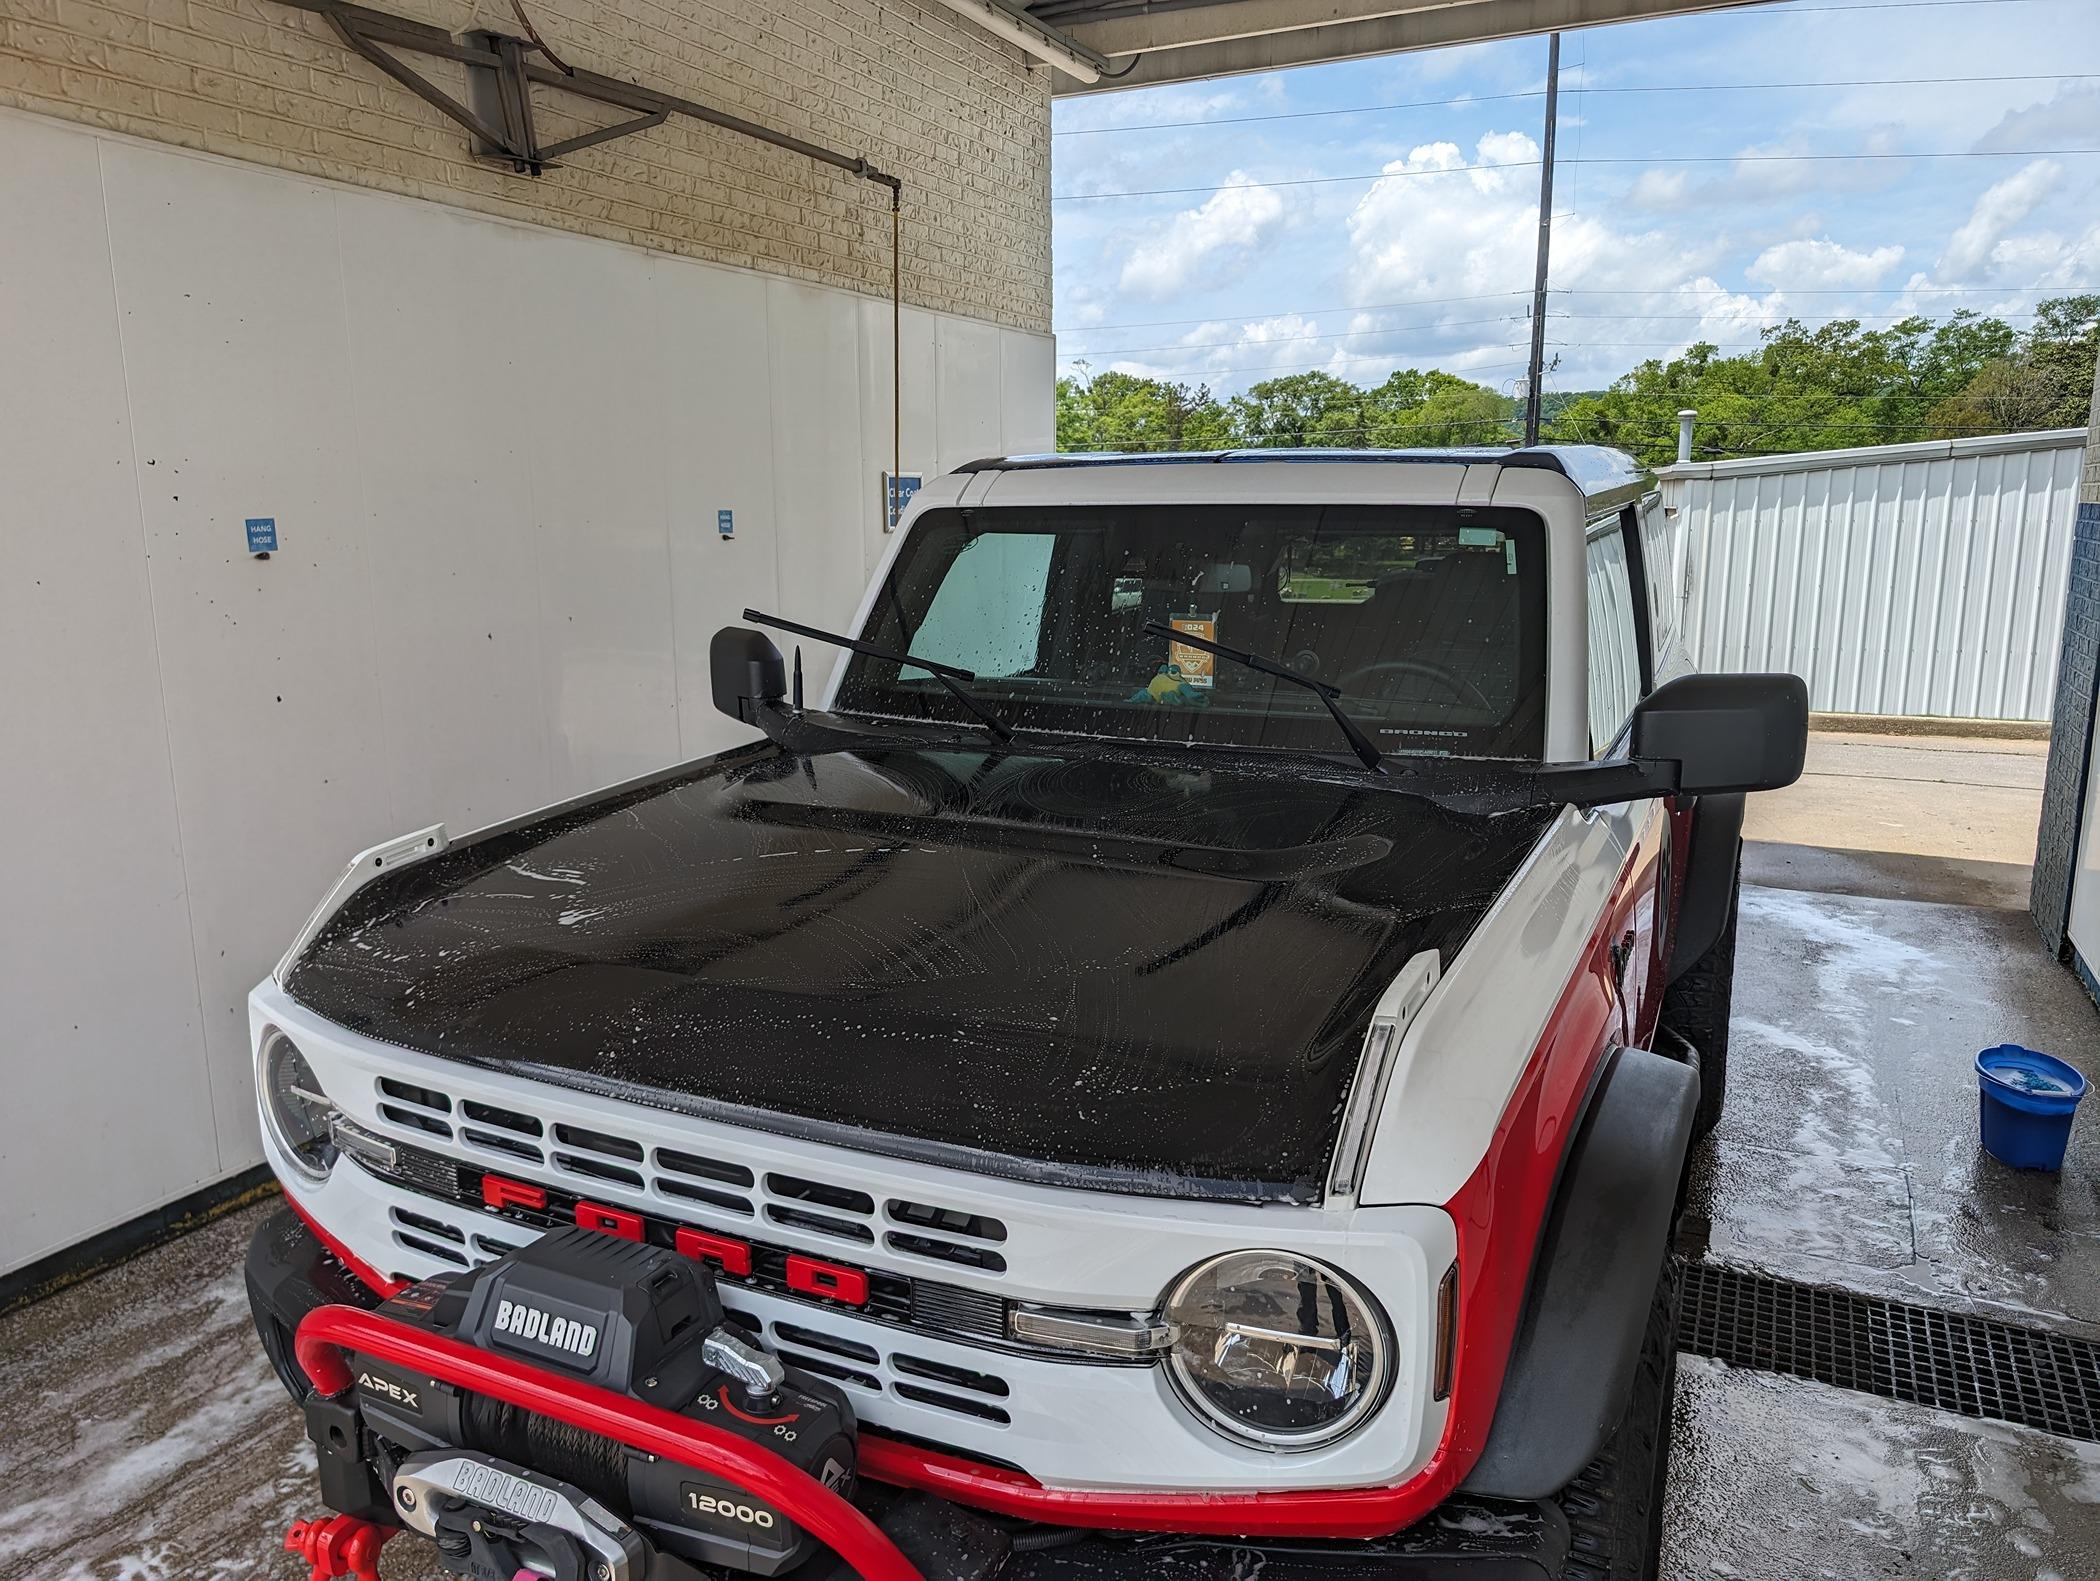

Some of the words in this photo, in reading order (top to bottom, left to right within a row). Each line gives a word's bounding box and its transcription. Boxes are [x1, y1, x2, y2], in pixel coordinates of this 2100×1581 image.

[250, 525, 272, 533] HANG
[253, 536, 272, 545] HOSE
[494, 1299, 597, 1357] BADLAND
[358, 1372, 419, 1409] APEX
[453, 1460, 559, 1524] BADLAND
[688, 1492, 774, 1528] 12000
